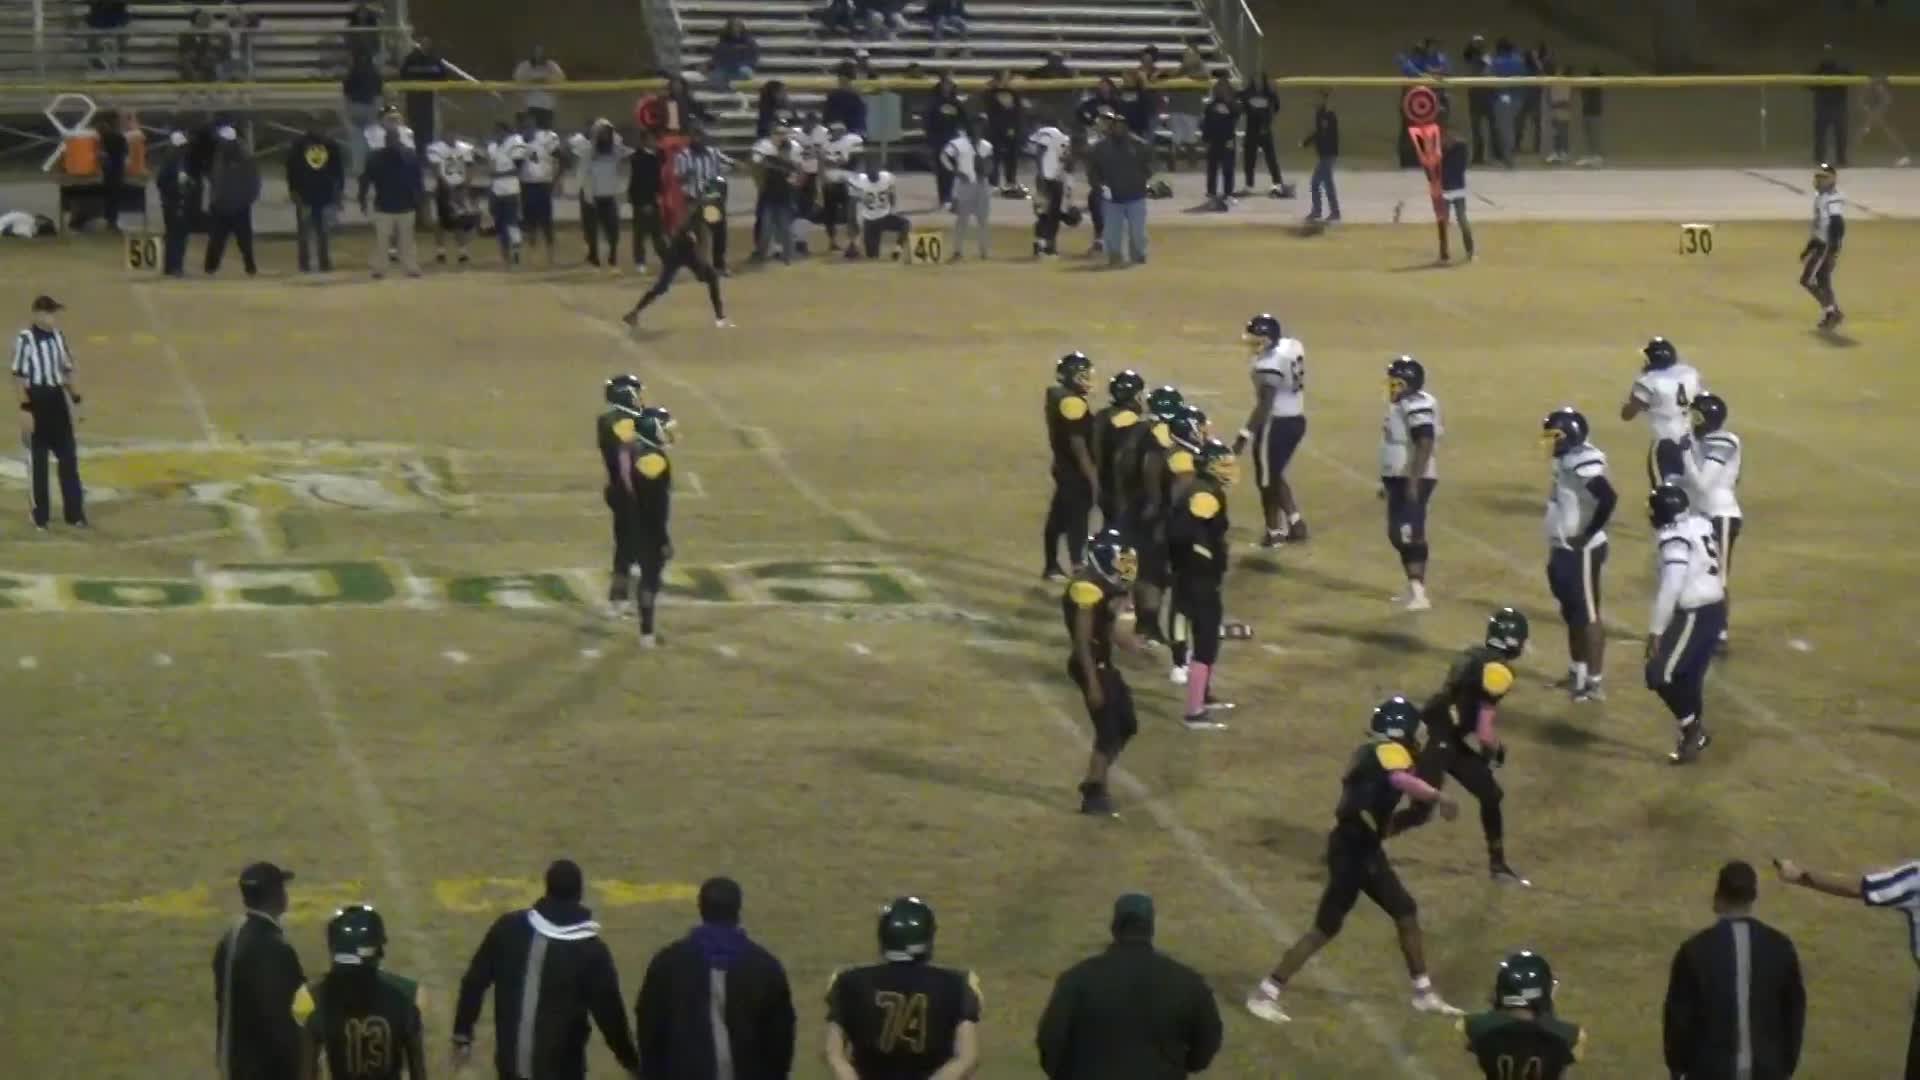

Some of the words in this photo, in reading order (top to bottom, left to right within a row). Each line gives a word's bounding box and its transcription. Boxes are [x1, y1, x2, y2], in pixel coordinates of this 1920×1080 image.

[129, 240, 156, 267] 50
[914, 236, 941, 262] 40
[1685, 228, 1712, 254] 30
[874, 990, 928, 1055] 74
[344, 1015, 392, 1079] 13
